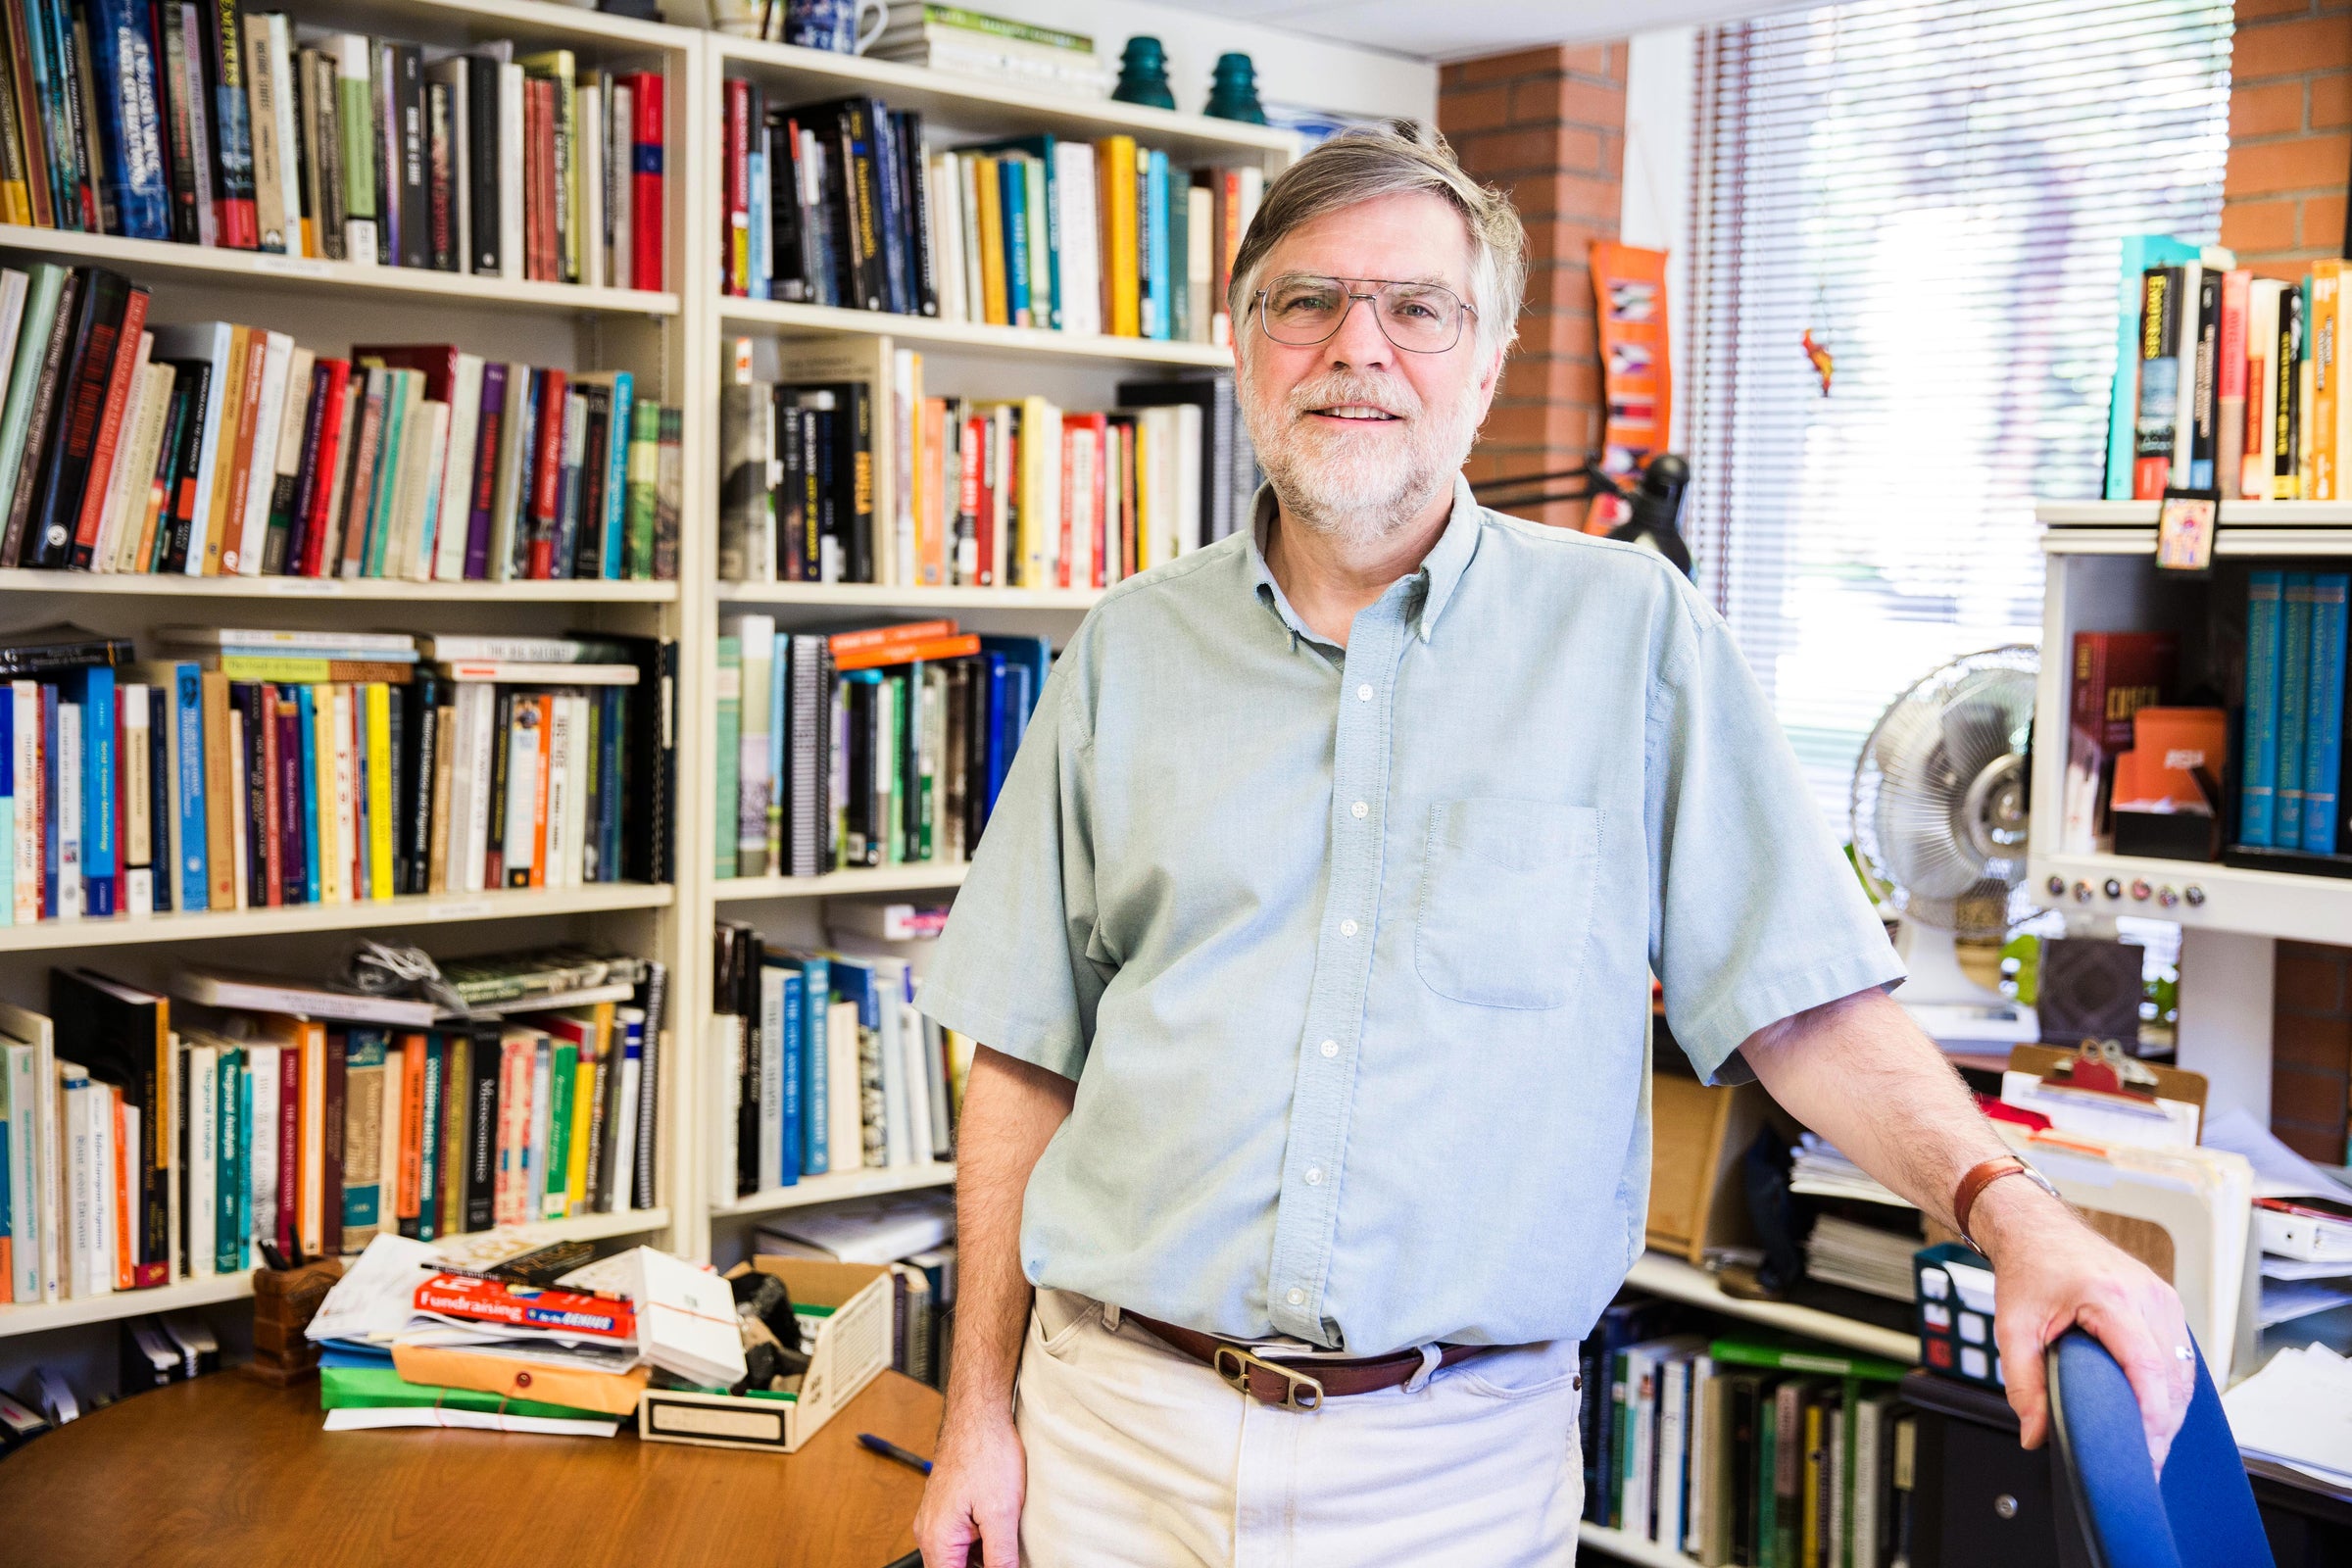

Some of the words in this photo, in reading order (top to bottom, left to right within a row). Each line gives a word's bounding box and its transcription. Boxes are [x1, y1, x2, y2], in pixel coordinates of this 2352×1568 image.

[221, 1063, 238, 1114] Regional
[221, 1115, 238, 1161] Analysis
[475, 1077, 495, 1184] Microeconomics
[420, 1291, 522, 1322] Fundraising
[563, 1311, 613, 1331] GENIUS
